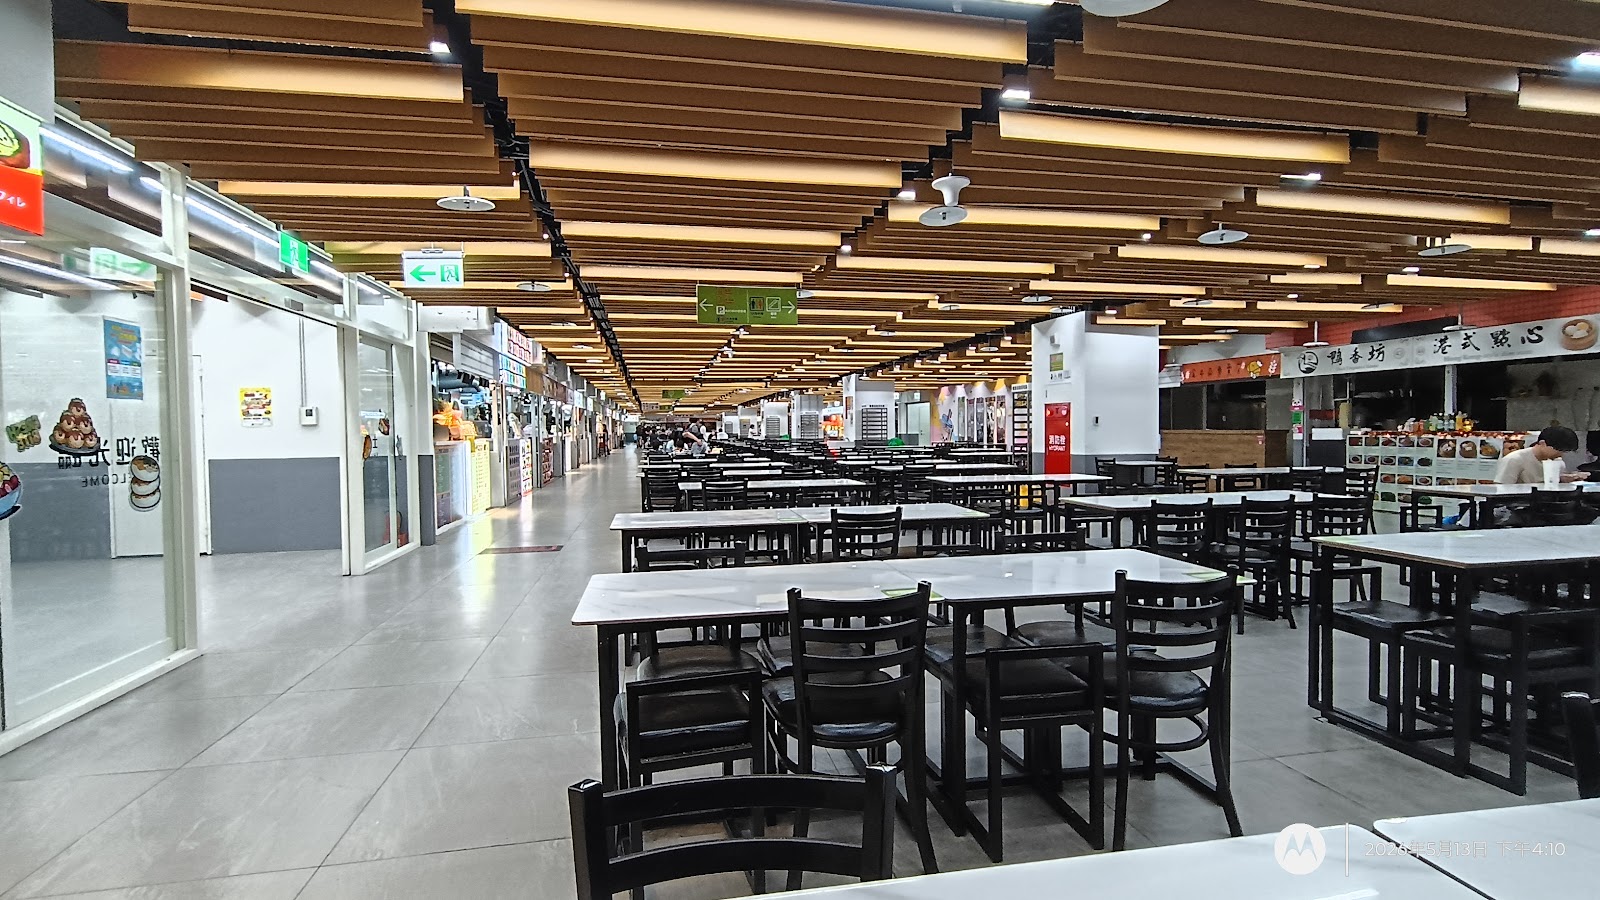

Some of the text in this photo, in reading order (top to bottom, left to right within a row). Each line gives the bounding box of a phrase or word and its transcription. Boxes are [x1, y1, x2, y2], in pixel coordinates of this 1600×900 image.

[1433, 325, 1544, 355] 港式點心
[1327, 343, 1385, 366] 鴨香坊
